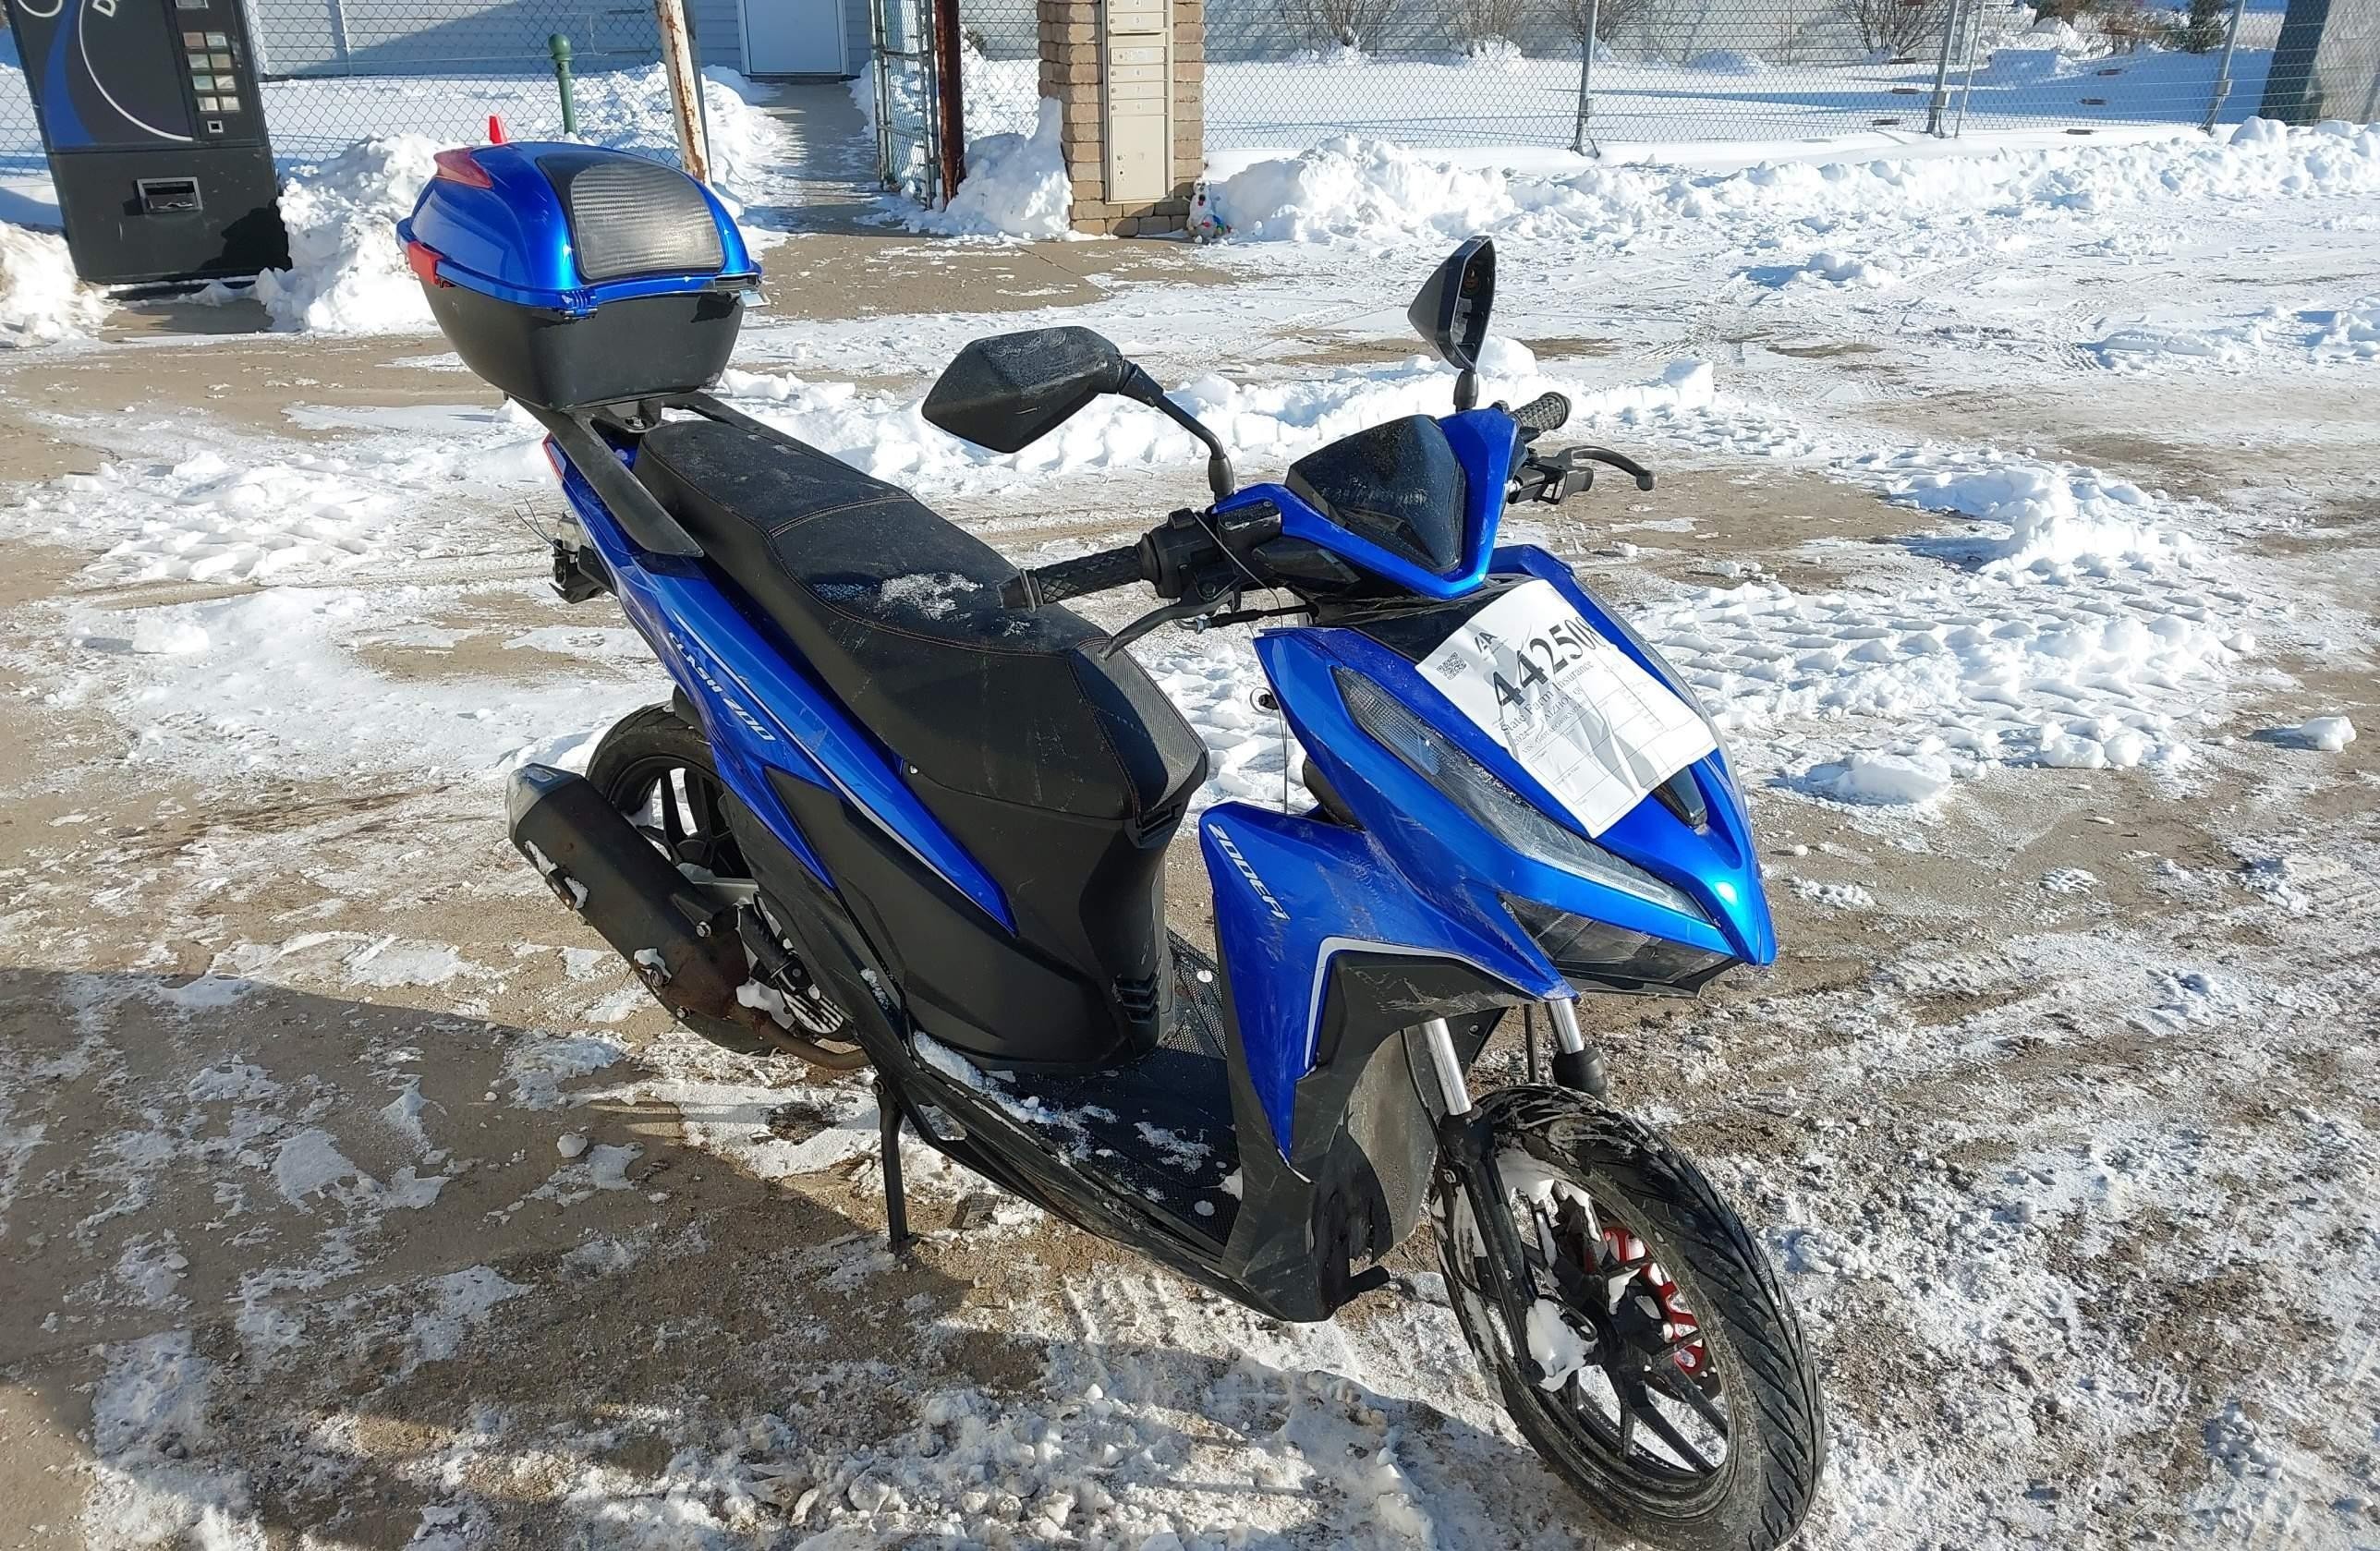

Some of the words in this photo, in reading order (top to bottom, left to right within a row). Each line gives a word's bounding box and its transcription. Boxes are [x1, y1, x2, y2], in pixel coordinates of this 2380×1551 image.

[668, 632, 722, 693] CLASH
[722, 697, 777, 742] 200
[1493, 616, 1610, 707] 442508
[1500, 714, 1527, 734] State
[1524, 689, 1554, 716] Farm
[1552, 660, 1595, 692] Insurance
